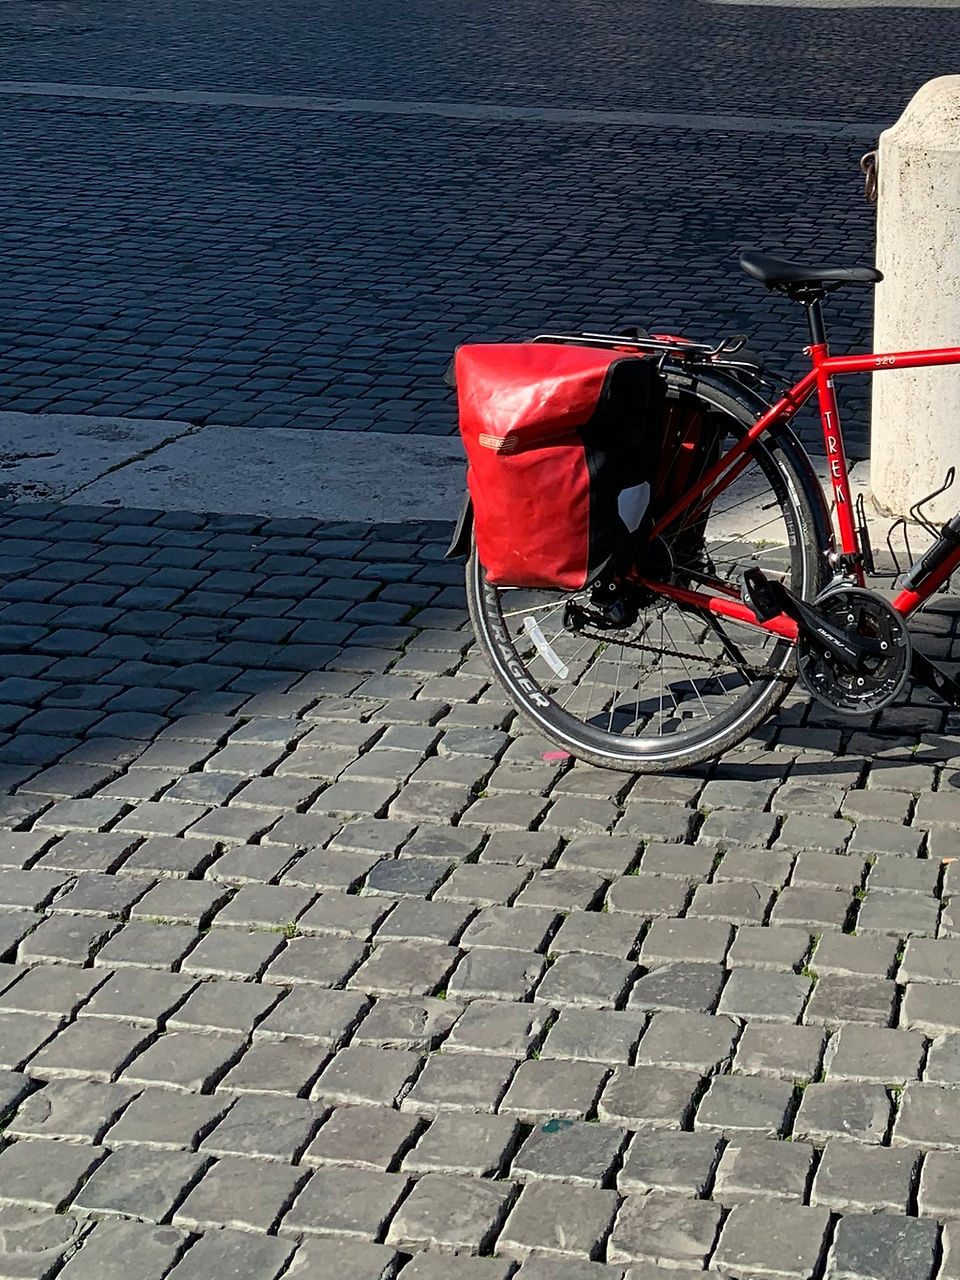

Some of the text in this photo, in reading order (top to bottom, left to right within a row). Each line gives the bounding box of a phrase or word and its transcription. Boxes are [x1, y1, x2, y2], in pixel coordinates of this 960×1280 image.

[875, 355, 896, 366] 520
[824, 410, 846, 504] TREK
[483, 582, 551, 709] NTRAGER
